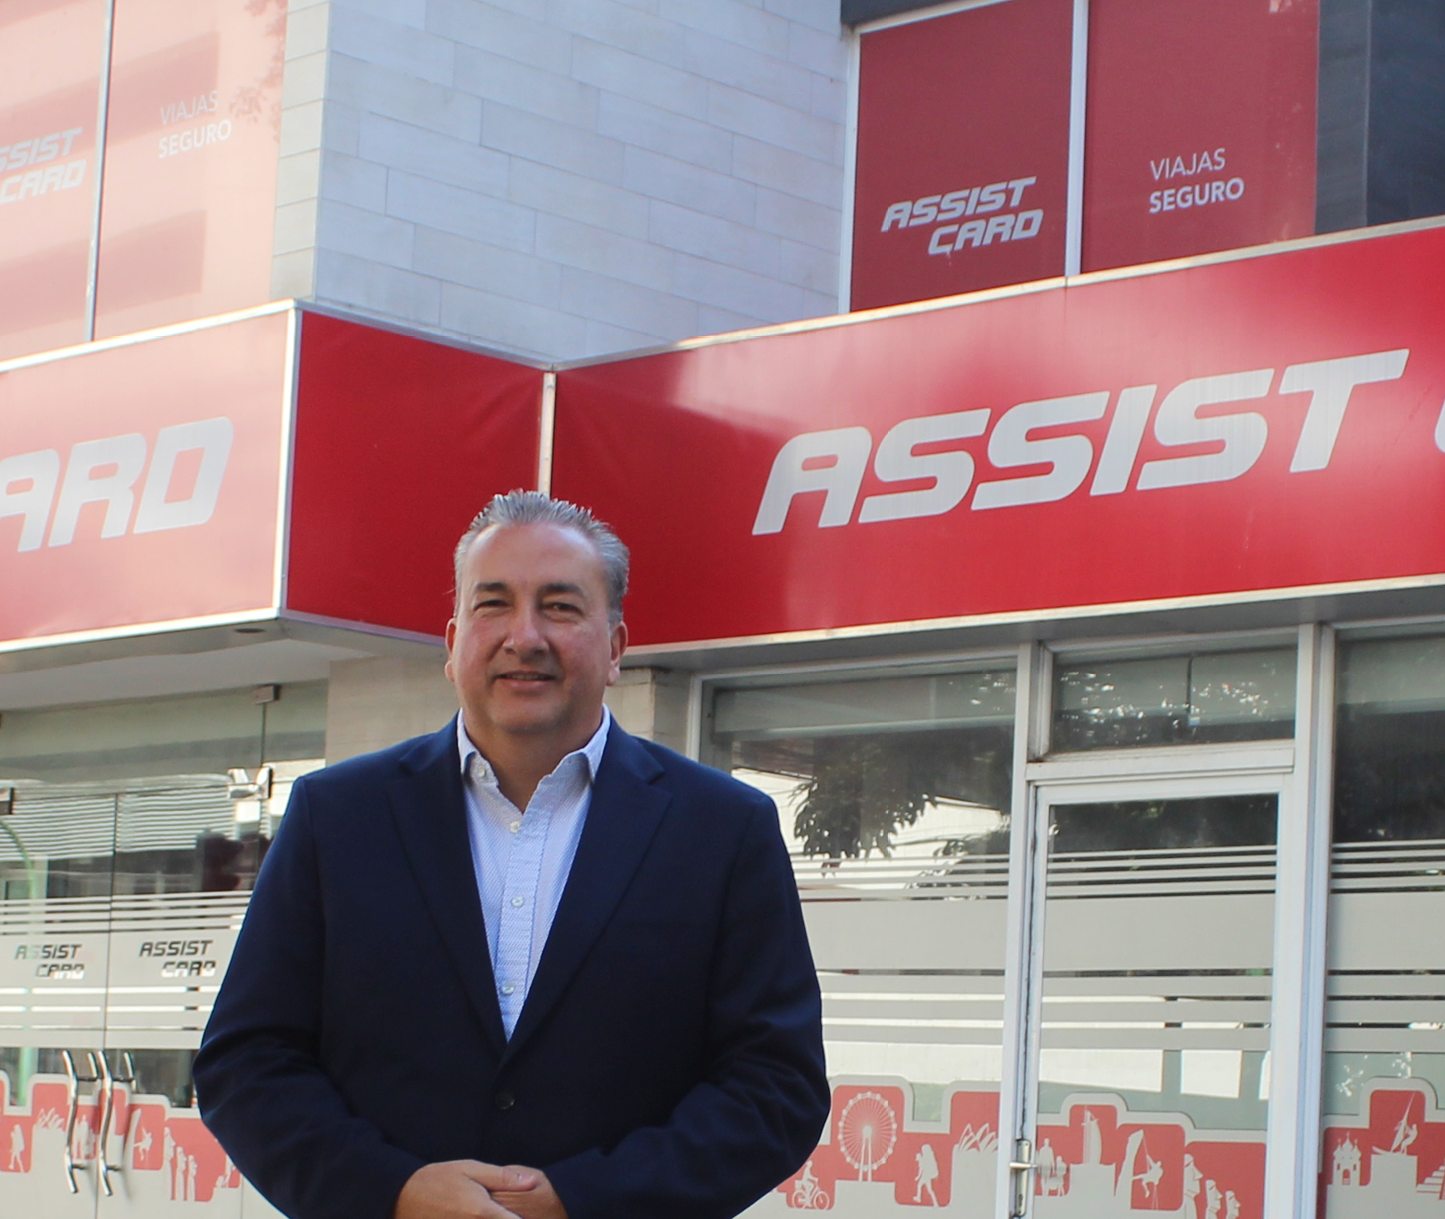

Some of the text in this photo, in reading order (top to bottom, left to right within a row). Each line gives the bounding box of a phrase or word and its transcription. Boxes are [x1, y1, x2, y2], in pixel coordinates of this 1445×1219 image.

[160, 90, 219, 124] VIAJAS
[158, 119, 232, 159] SEGURO
[1150, 148, 1226, 180] VIAJAS
[881, 176, 1037, 232] ASSIST
[1149, 177, 1245, 214] SEGURO
[927, 209, 1044, 255] CARD
[753, 349, 1410, 535] ASSIST
[15, 943, 83, 960] ASSIST
[139, 939, 214, 957] ASSIST
[36, 963, 85, 979] CARD
[161, 960, 217, 978] CARD
